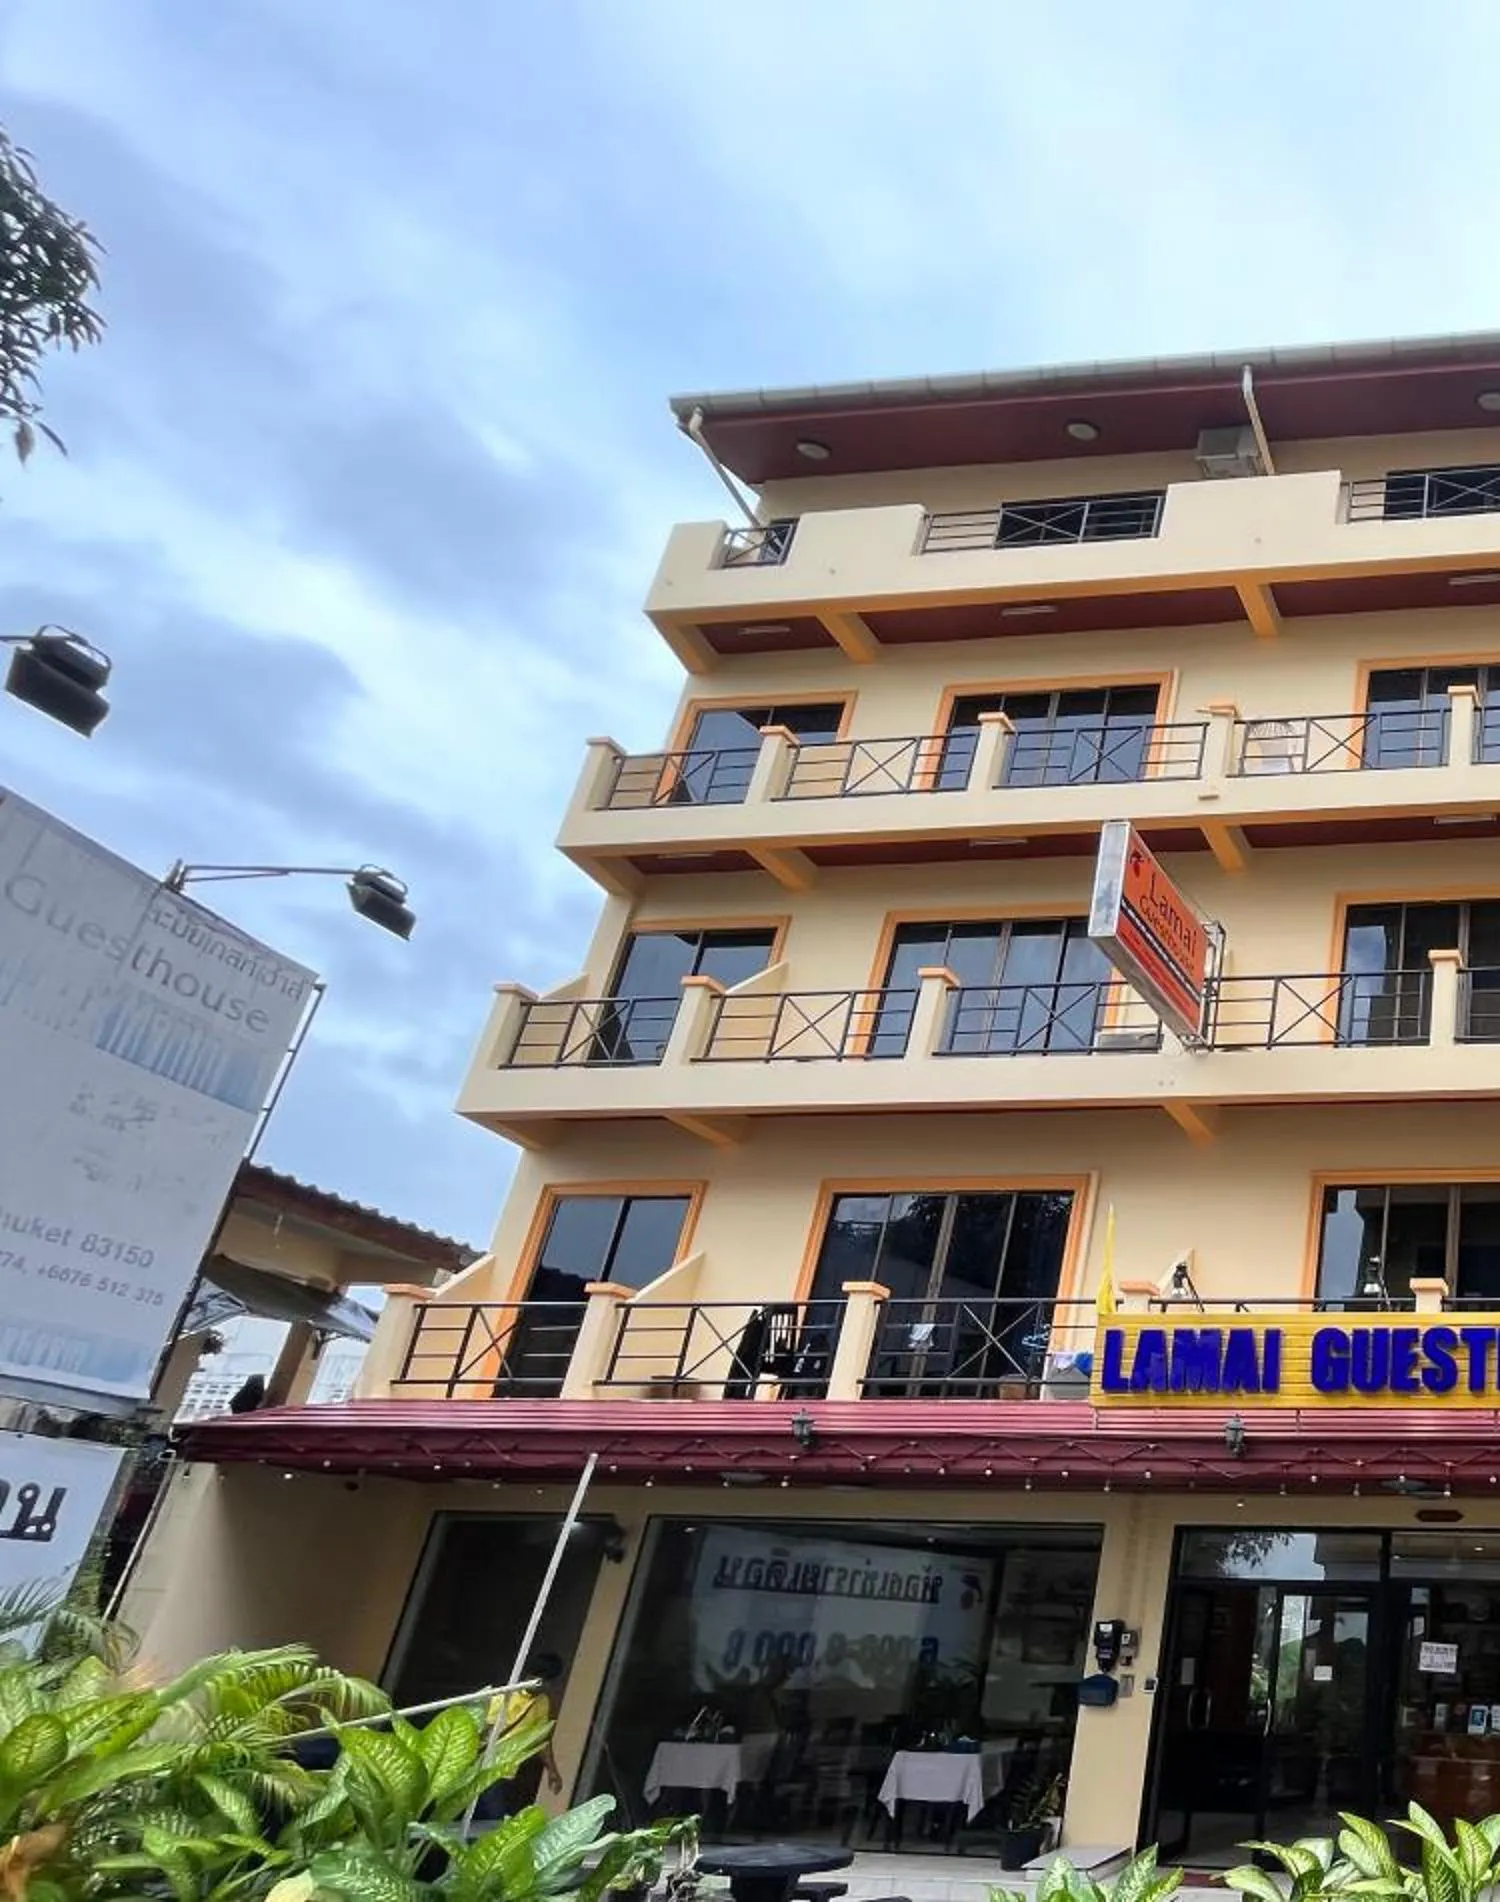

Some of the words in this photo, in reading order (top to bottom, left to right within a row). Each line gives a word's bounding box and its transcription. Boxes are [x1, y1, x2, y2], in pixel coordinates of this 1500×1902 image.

[1150, 874, 1198, 957] Lamai
[4, 874, 270, 1034] Guesthouse
[79, 1232, 155, 1268] 83150
[1102, 1327, 1282, 1395] LAMAI
